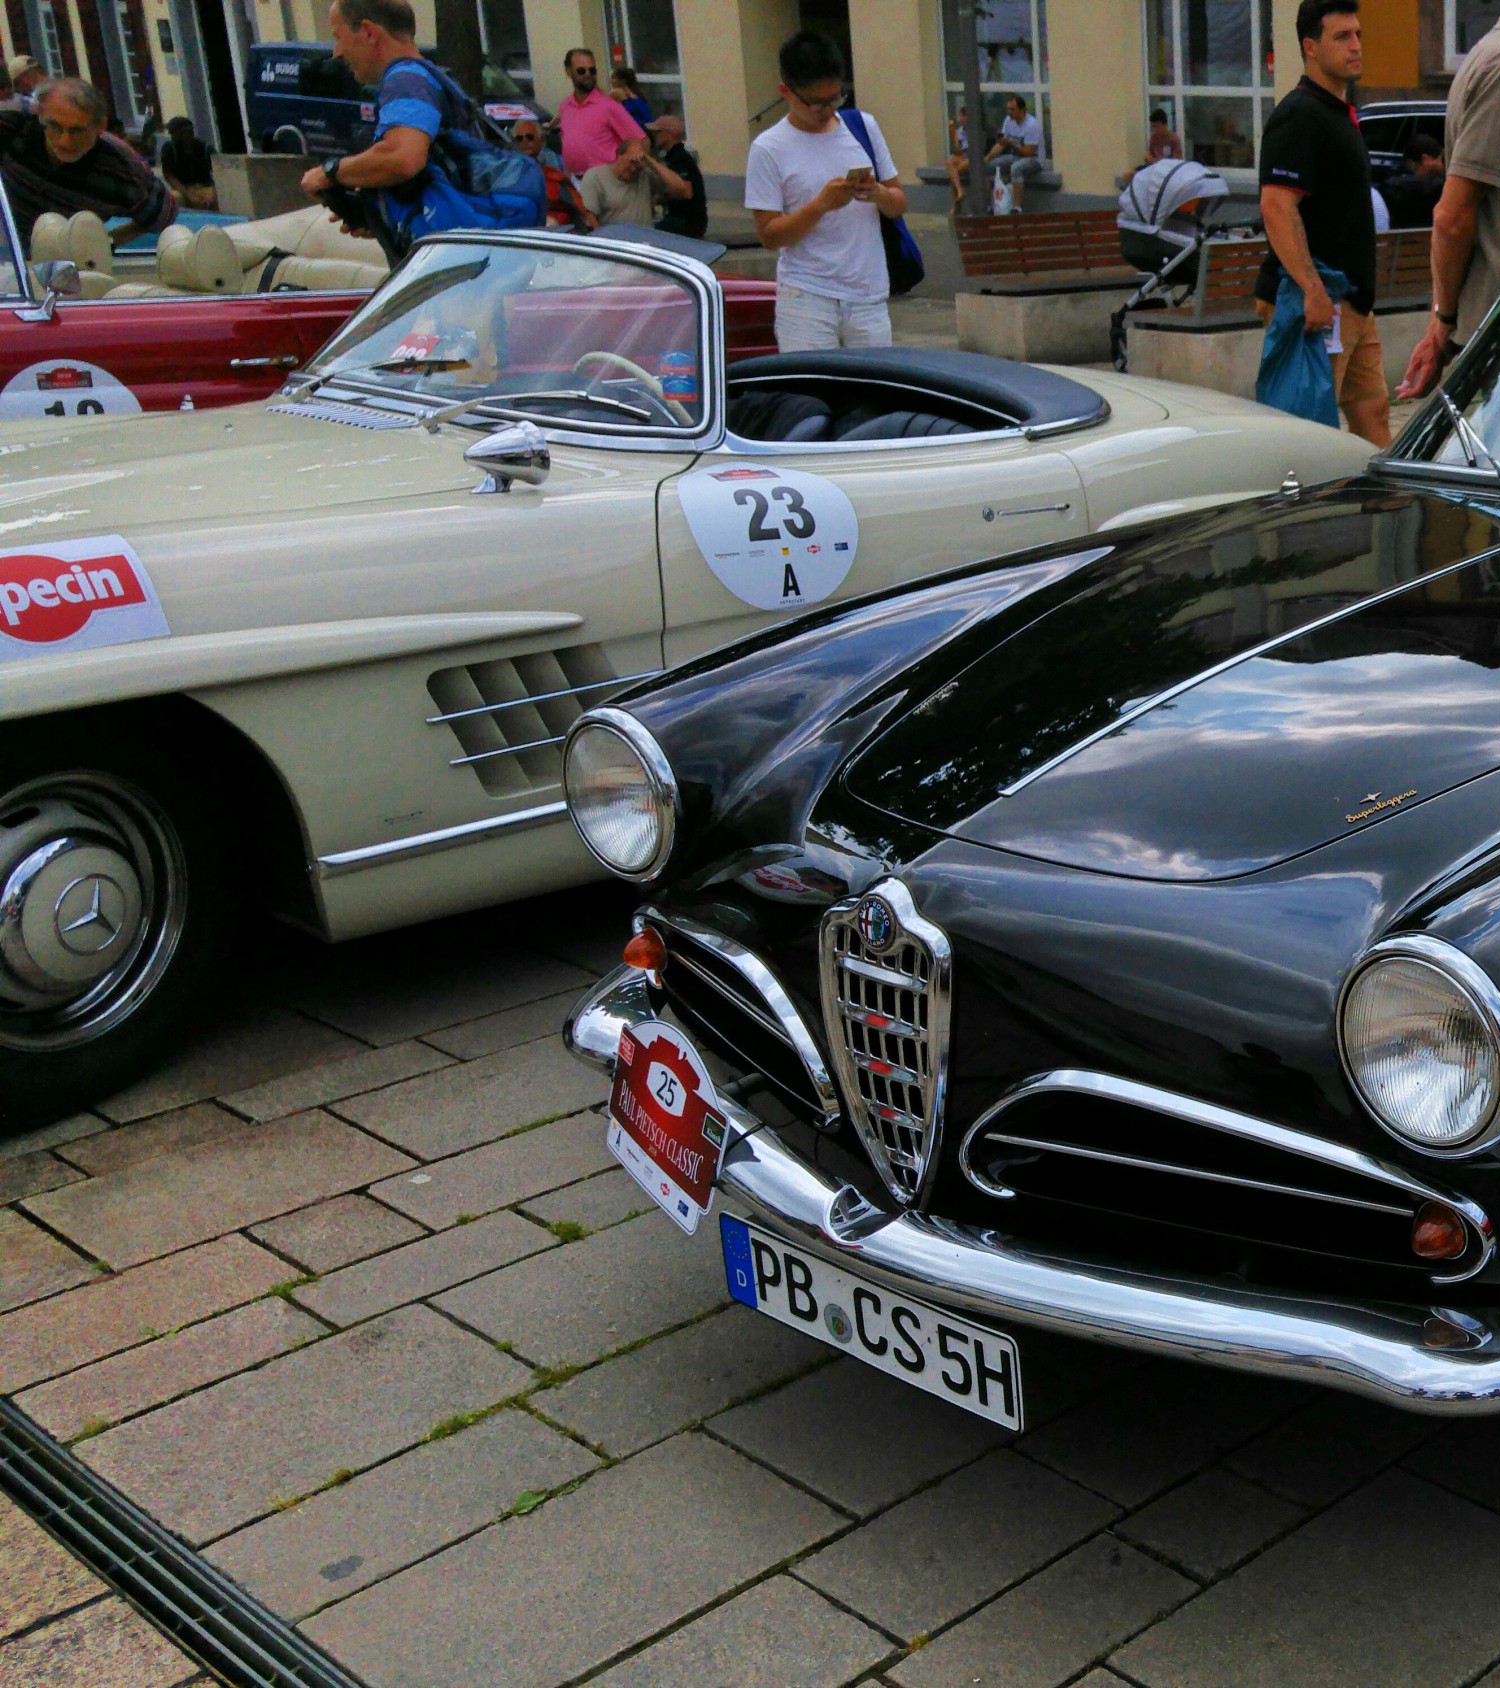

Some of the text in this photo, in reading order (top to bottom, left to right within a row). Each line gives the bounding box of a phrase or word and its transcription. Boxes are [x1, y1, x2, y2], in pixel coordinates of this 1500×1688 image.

[733, 486, 816, 542] 23
[0, 565, 125, 626] pecin
[782, 563, 801, 597] A
[1345, 789, 1418, 823] Superleggera
[656, 1071, 677, 1108] 25
[618, 1079, 636, 1122] PAUL
[635, 1105, 667, 1153] PIETSCH
[667, 1138, 704, 1184] CLASSIC
[737, 1268, 747, 1287] D
[750, 1237, 818, 1322] PB
